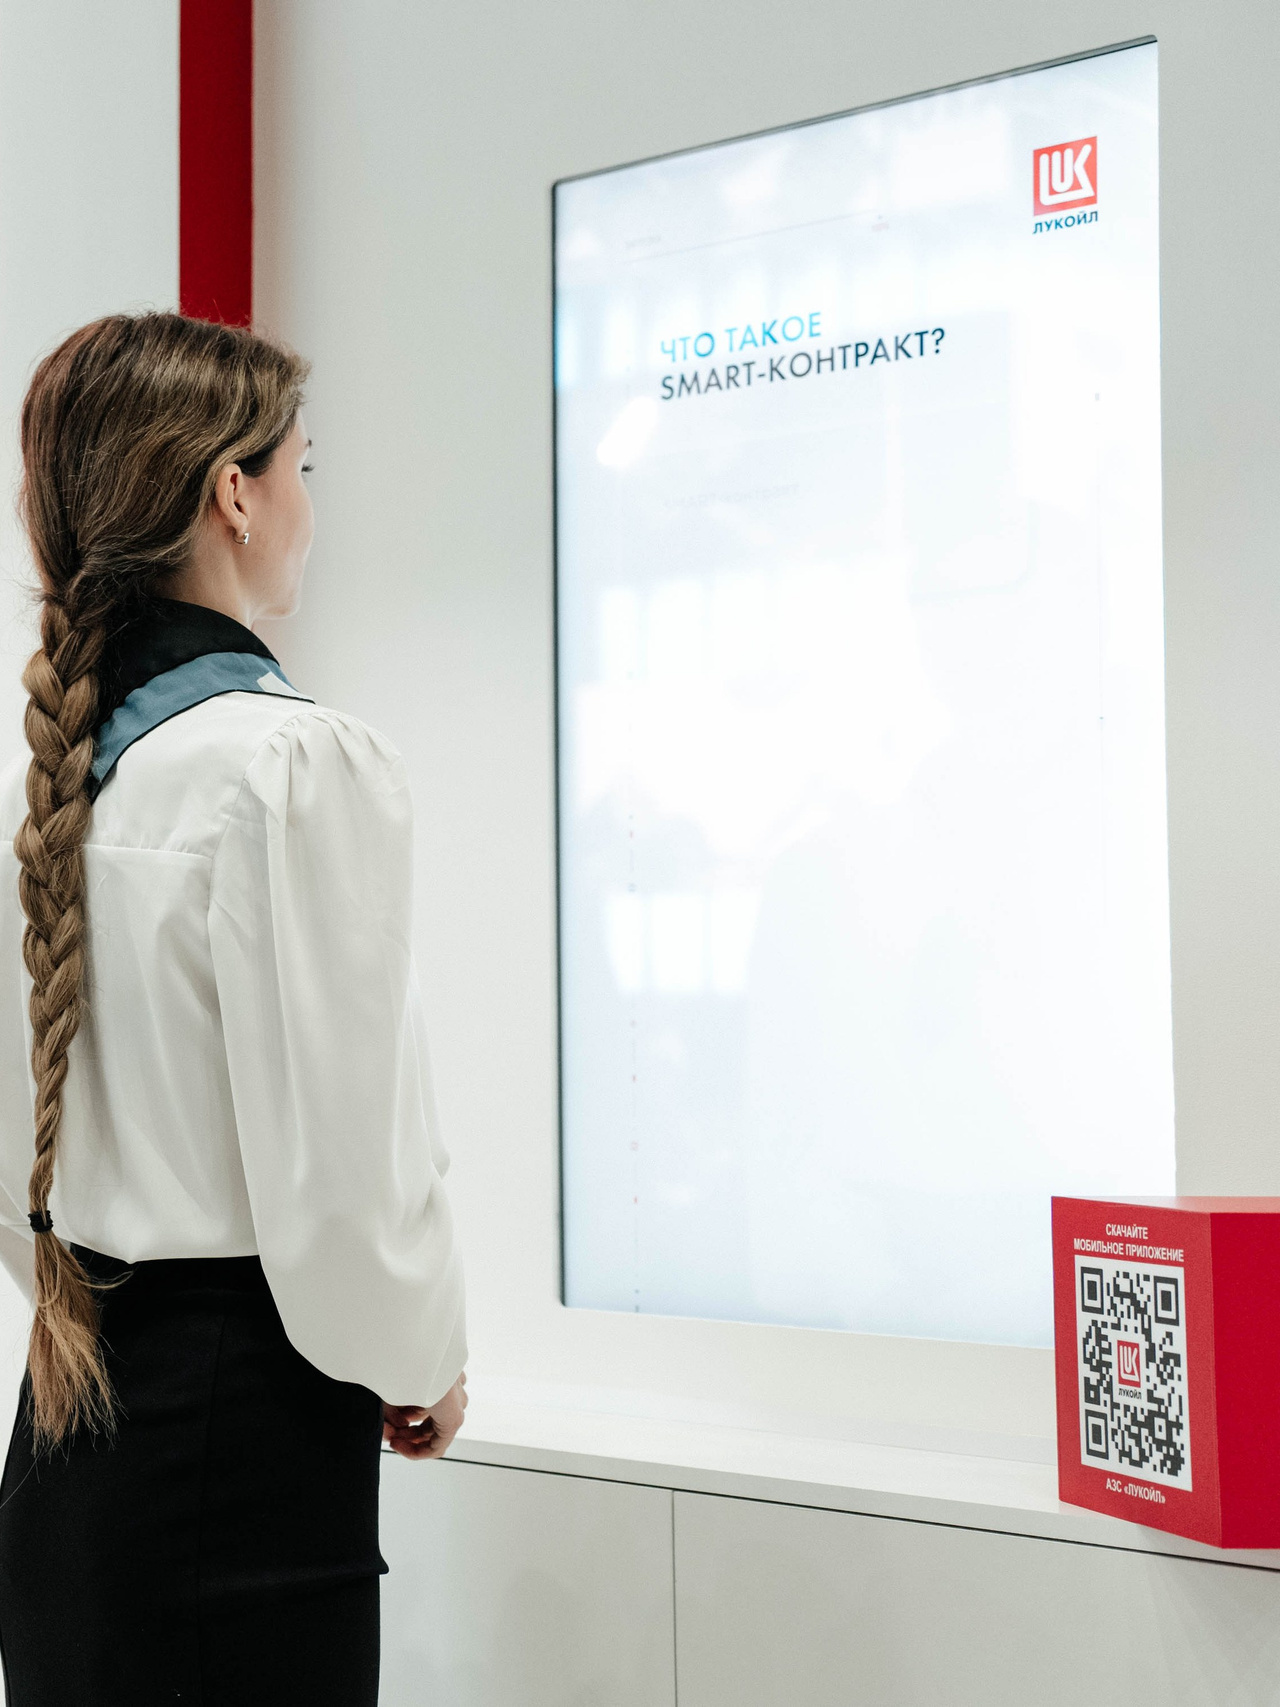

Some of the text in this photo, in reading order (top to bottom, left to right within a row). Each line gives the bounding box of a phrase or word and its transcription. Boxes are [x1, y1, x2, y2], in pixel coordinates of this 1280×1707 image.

[1032, 210, 1099, 235] ЛУКОЙЛ
[660, 311, 822, 364] ЧТО ТАКОЕ
[660, 327, 946, 401] SMART-КОНТРАКТ?
[1105, 1223, 1149, 1240] СКАЧАЙТЕ
[1073, 1237, 1185, 1262] МОБИЛЬНОЕ ПРИЛОЖЕНИЕ
[1118, 1388, 1143, 1400] ЛУКОЙЛ
[1106, 1477, 1166, 1505] АЗС «ЛУКОЙЛ»
